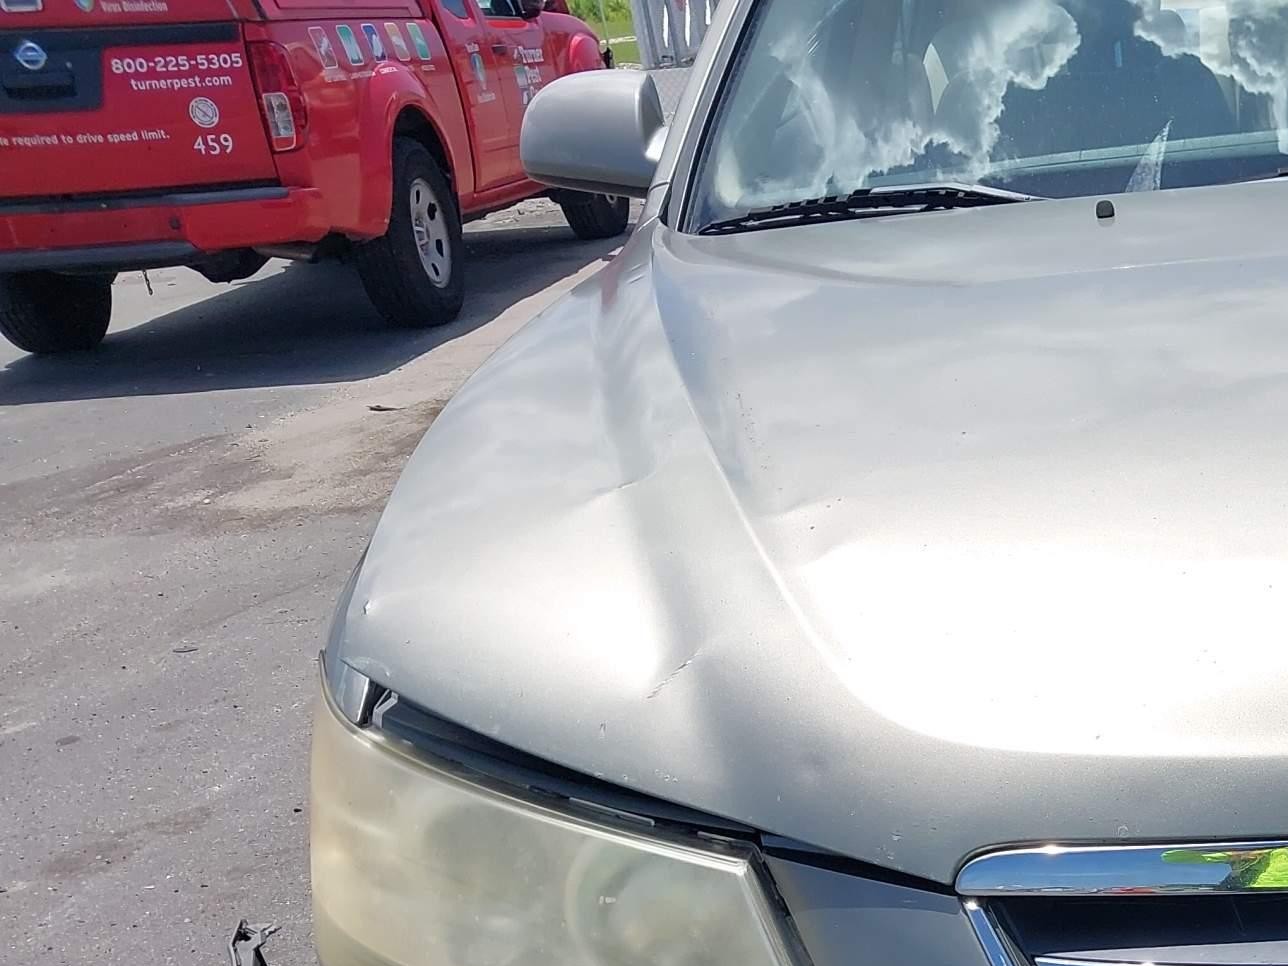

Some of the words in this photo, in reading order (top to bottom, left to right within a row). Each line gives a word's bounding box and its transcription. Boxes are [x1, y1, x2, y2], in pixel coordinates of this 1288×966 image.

[111, 53, 243, 74] 800-225-5305
[130, 75, 233, 91] turnerpest.com
[13, 134, 59, 147] required
[62, 134, 74, 144] to
[76, 133, 103, 144] drive
[107, 130, 139, 143] speed
[141, 129, 171, 140] limit.
[193, 133, 233, 155] 459
